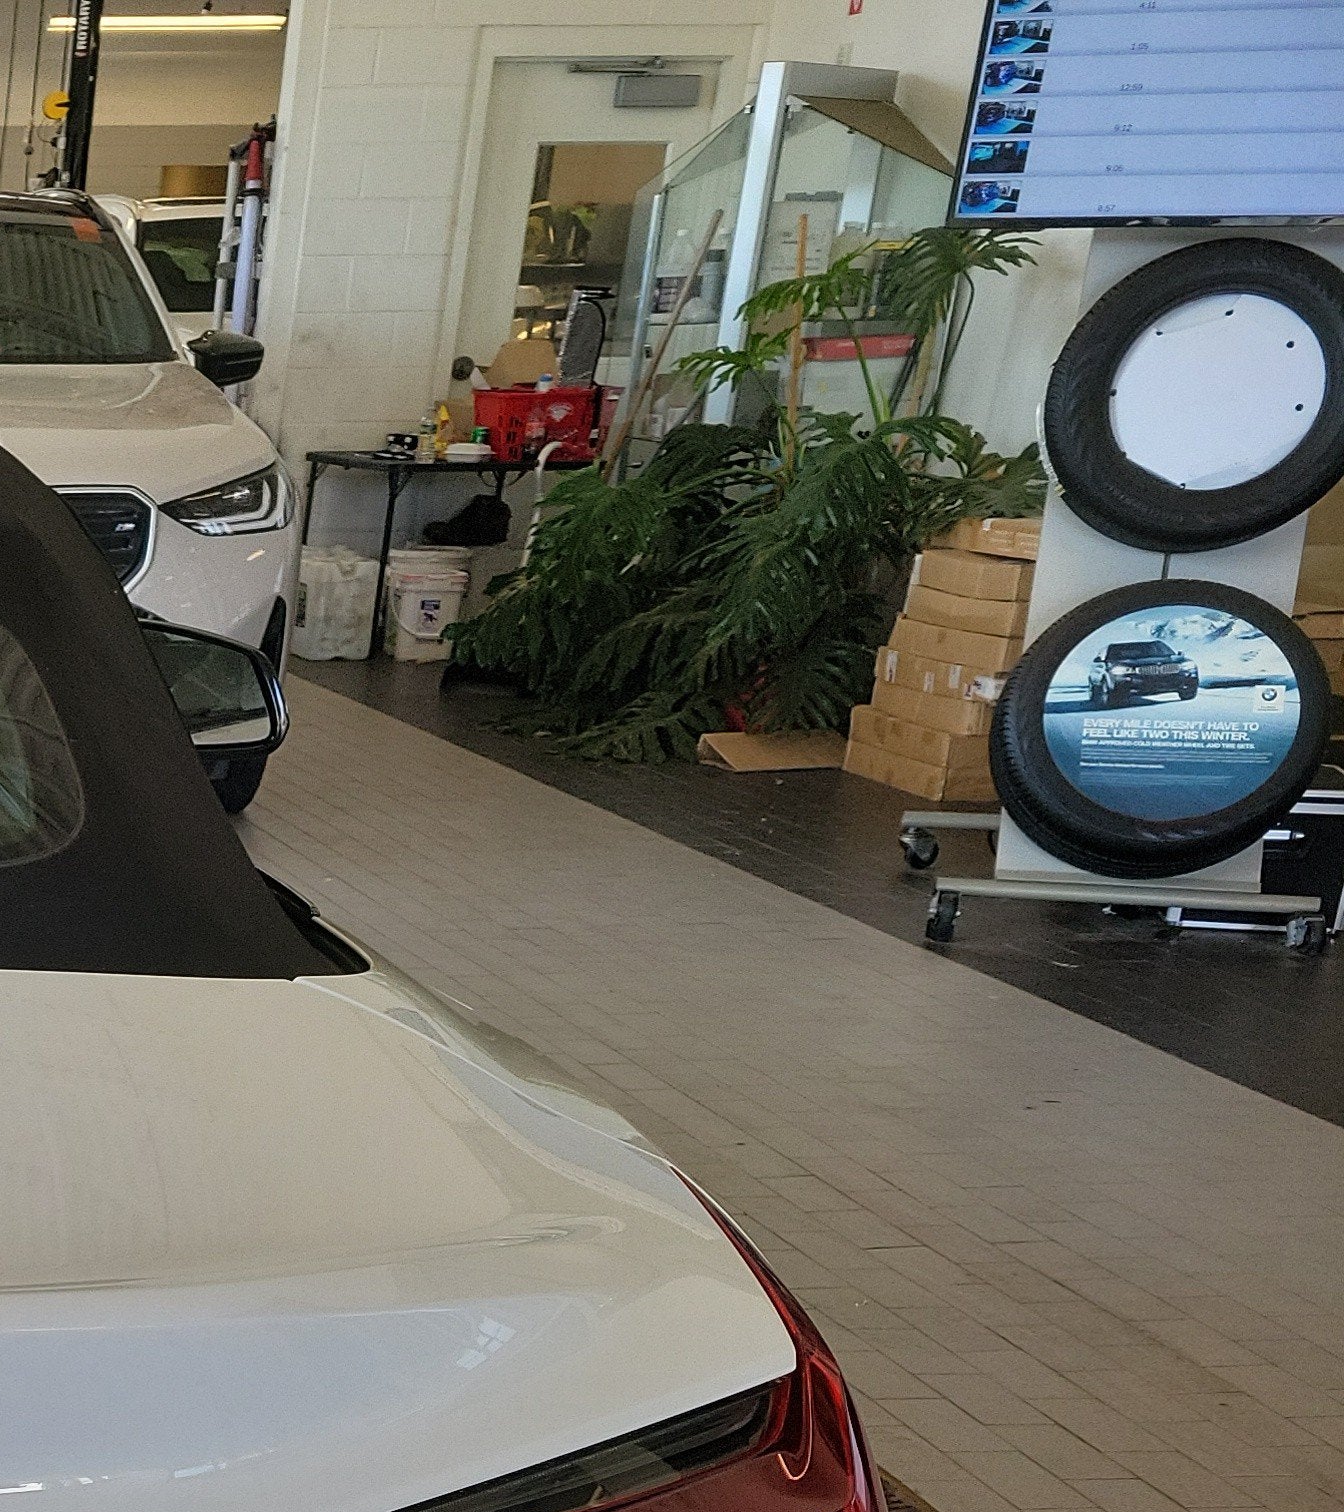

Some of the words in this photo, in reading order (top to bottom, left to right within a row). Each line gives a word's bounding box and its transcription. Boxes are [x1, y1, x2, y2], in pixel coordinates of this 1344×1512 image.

[1083, 718, 1122, 728] EVERY
[1123, 719, 1151, 729] MILE
[1207, 721, 1240, 731] HAVE
[1243, 722, 1259, 731] TO
[1082, 728, 1111, 738] FEEL
[1113, 729, 1139, 738] LIKE
[1141, 730, 1170, 739] TWO
[1171, 730, 1199, 740] THIS
[1201, 731, 1250, 741] WINTER.
